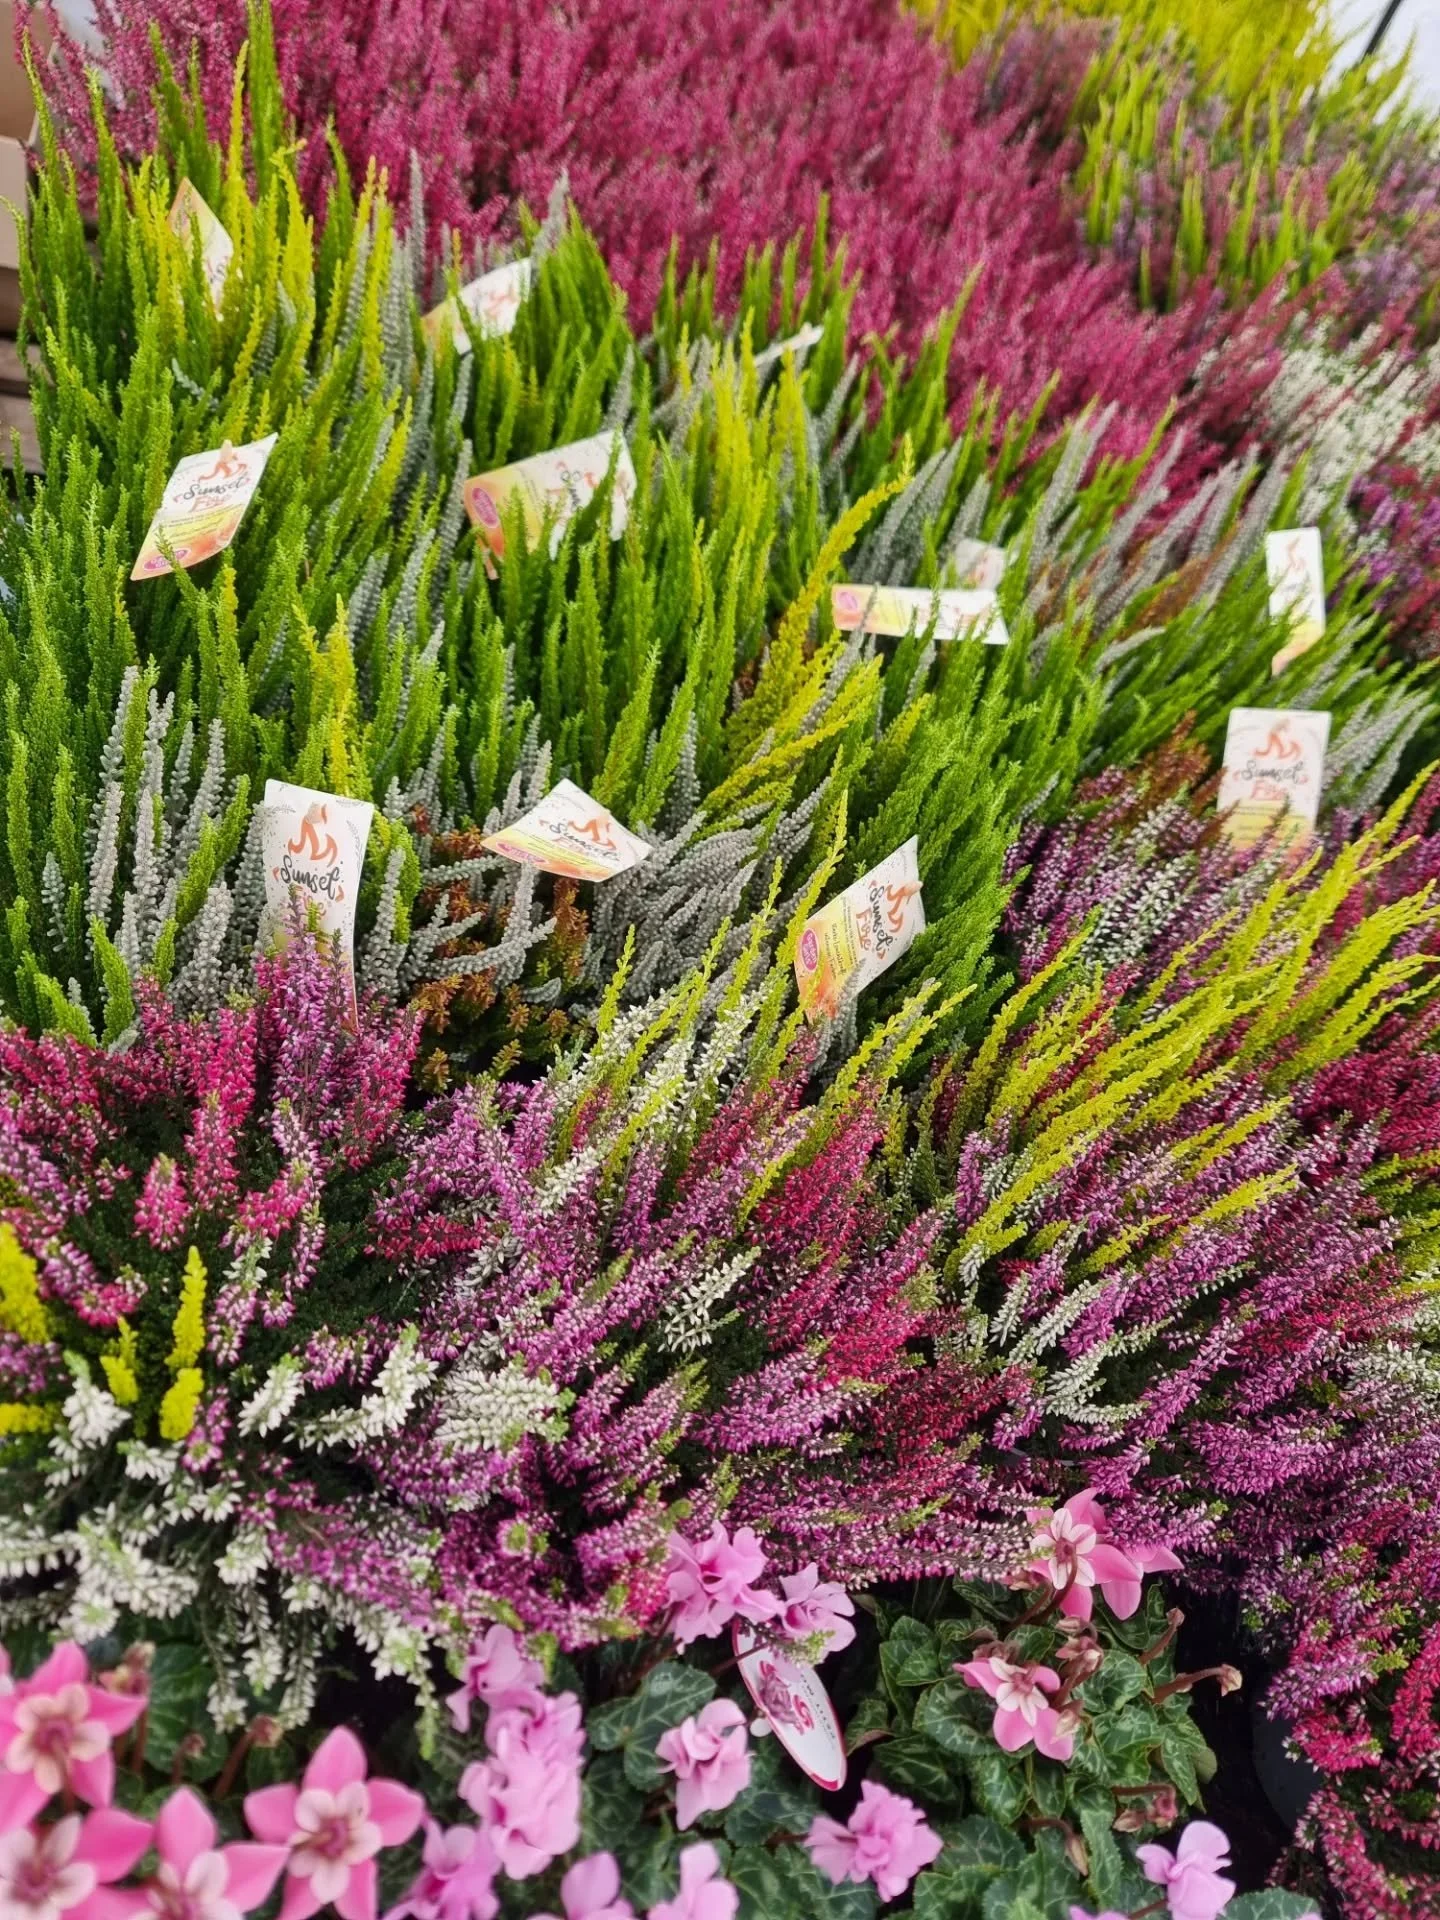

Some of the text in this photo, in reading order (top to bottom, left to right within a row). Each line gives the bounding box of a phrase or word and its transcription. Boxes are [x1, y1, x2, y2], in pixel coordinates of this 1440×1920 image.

[183, 475, 246, 500] Sunset
[1241, 760, 1304, 785] Sunset
[280, 854, 340, 900] Sunset
[869, 885, 894, 952] Sunset
